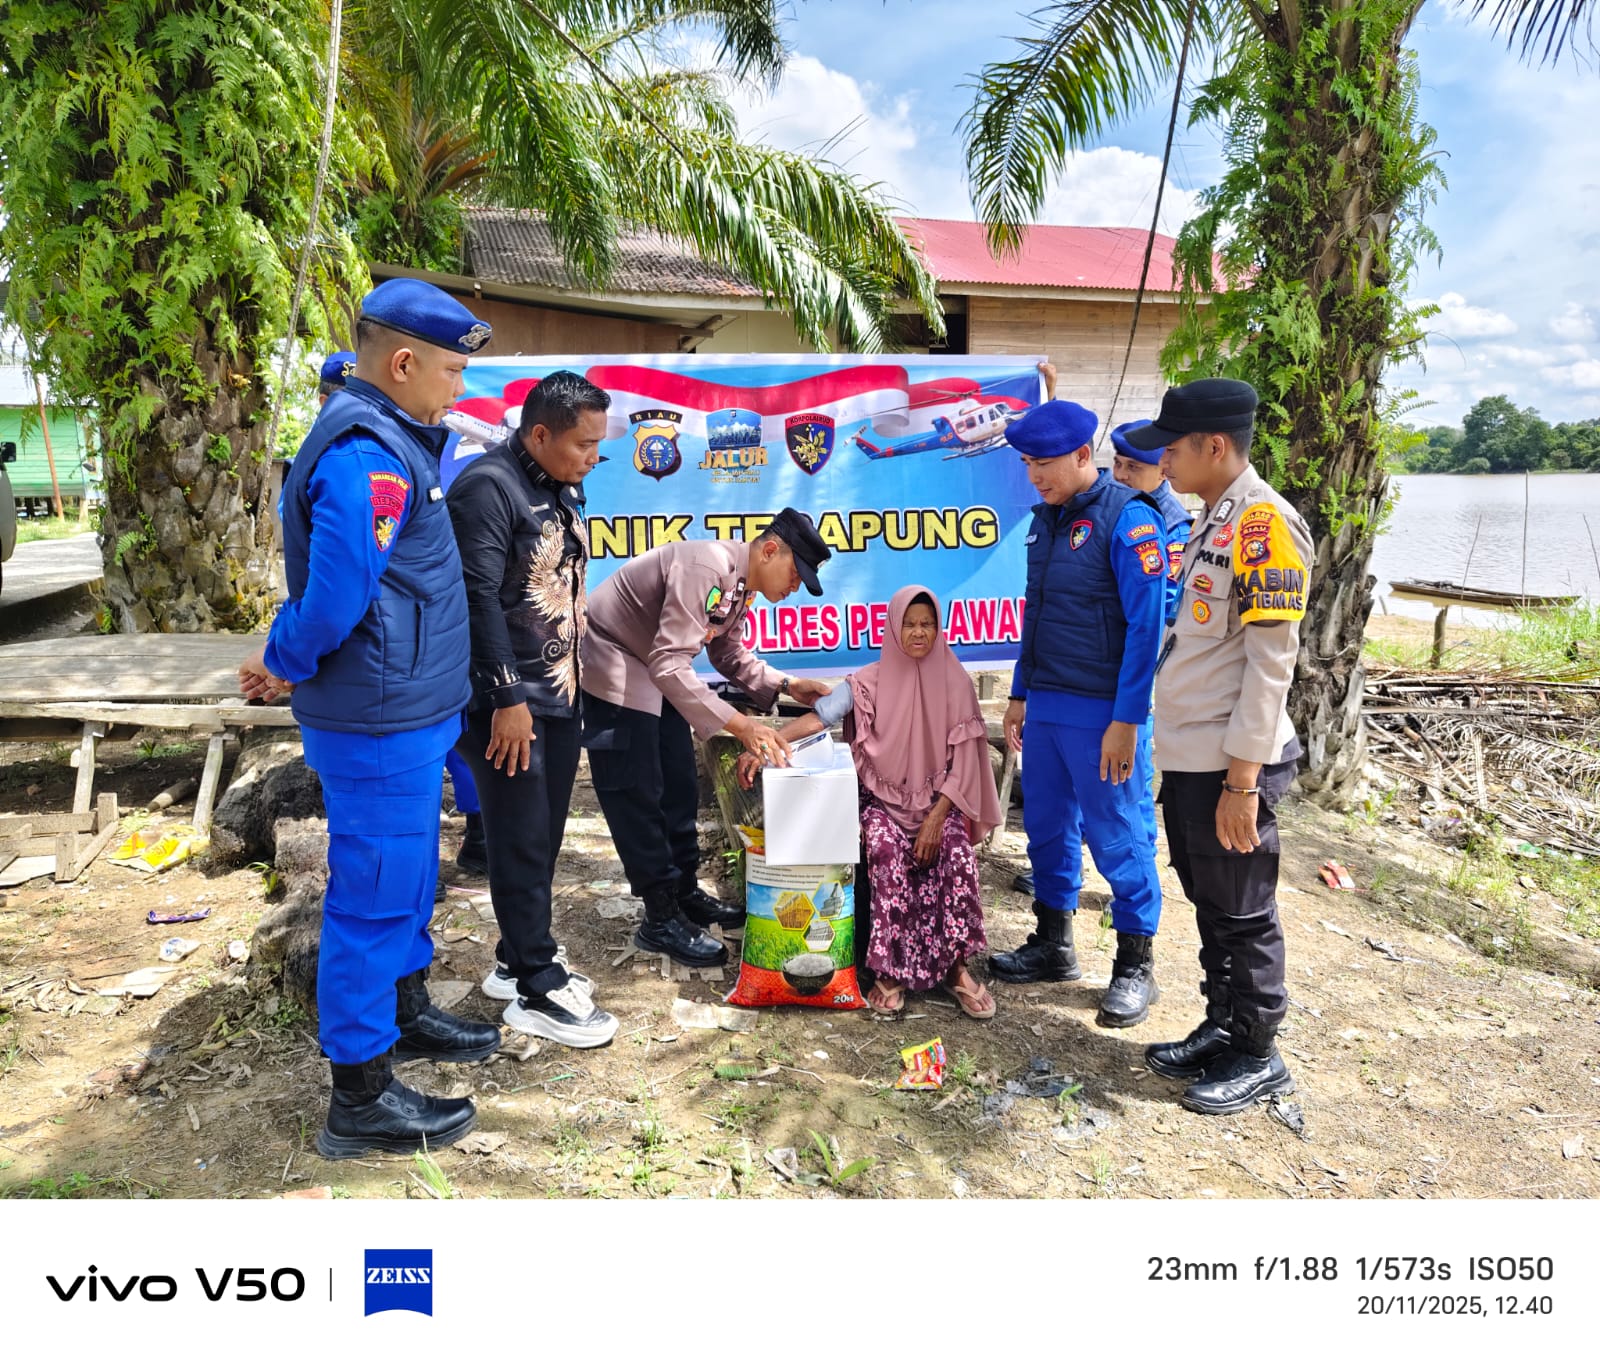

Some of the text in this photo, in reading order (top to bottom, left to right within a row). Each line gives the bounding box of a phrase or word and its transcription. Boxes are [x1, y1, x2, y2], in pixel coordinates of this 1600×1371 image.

[635, 413, 678, 421] RIAU
[699, 446, 769, 470] JALUR
[588, 515, 693, 559] NIK
[1243, 527, 1267, 535] RIAU
[1198, 549, 1230, 569] POLRI
[742, 604, 841, 652] OLRES
